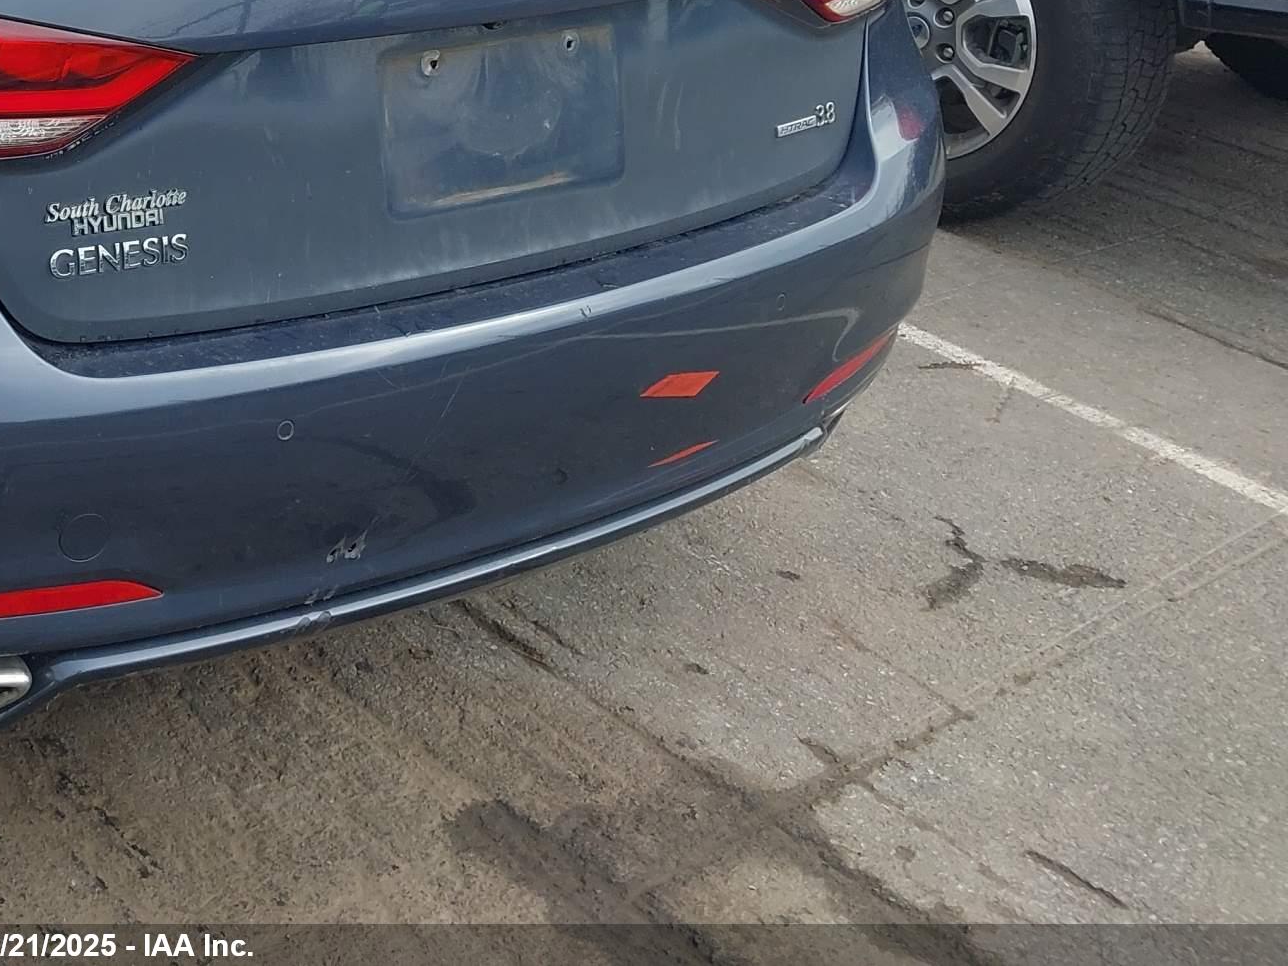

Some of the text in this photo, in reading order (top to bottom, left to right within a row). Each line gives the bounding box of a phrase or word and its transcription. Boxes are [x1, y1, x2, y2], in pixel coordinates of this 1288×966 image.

[46, 187, 188, 223] South Charlotte
[72, 208, 165, 236] HYUNDAI
[49, 233, 189, 278] GENESIS
